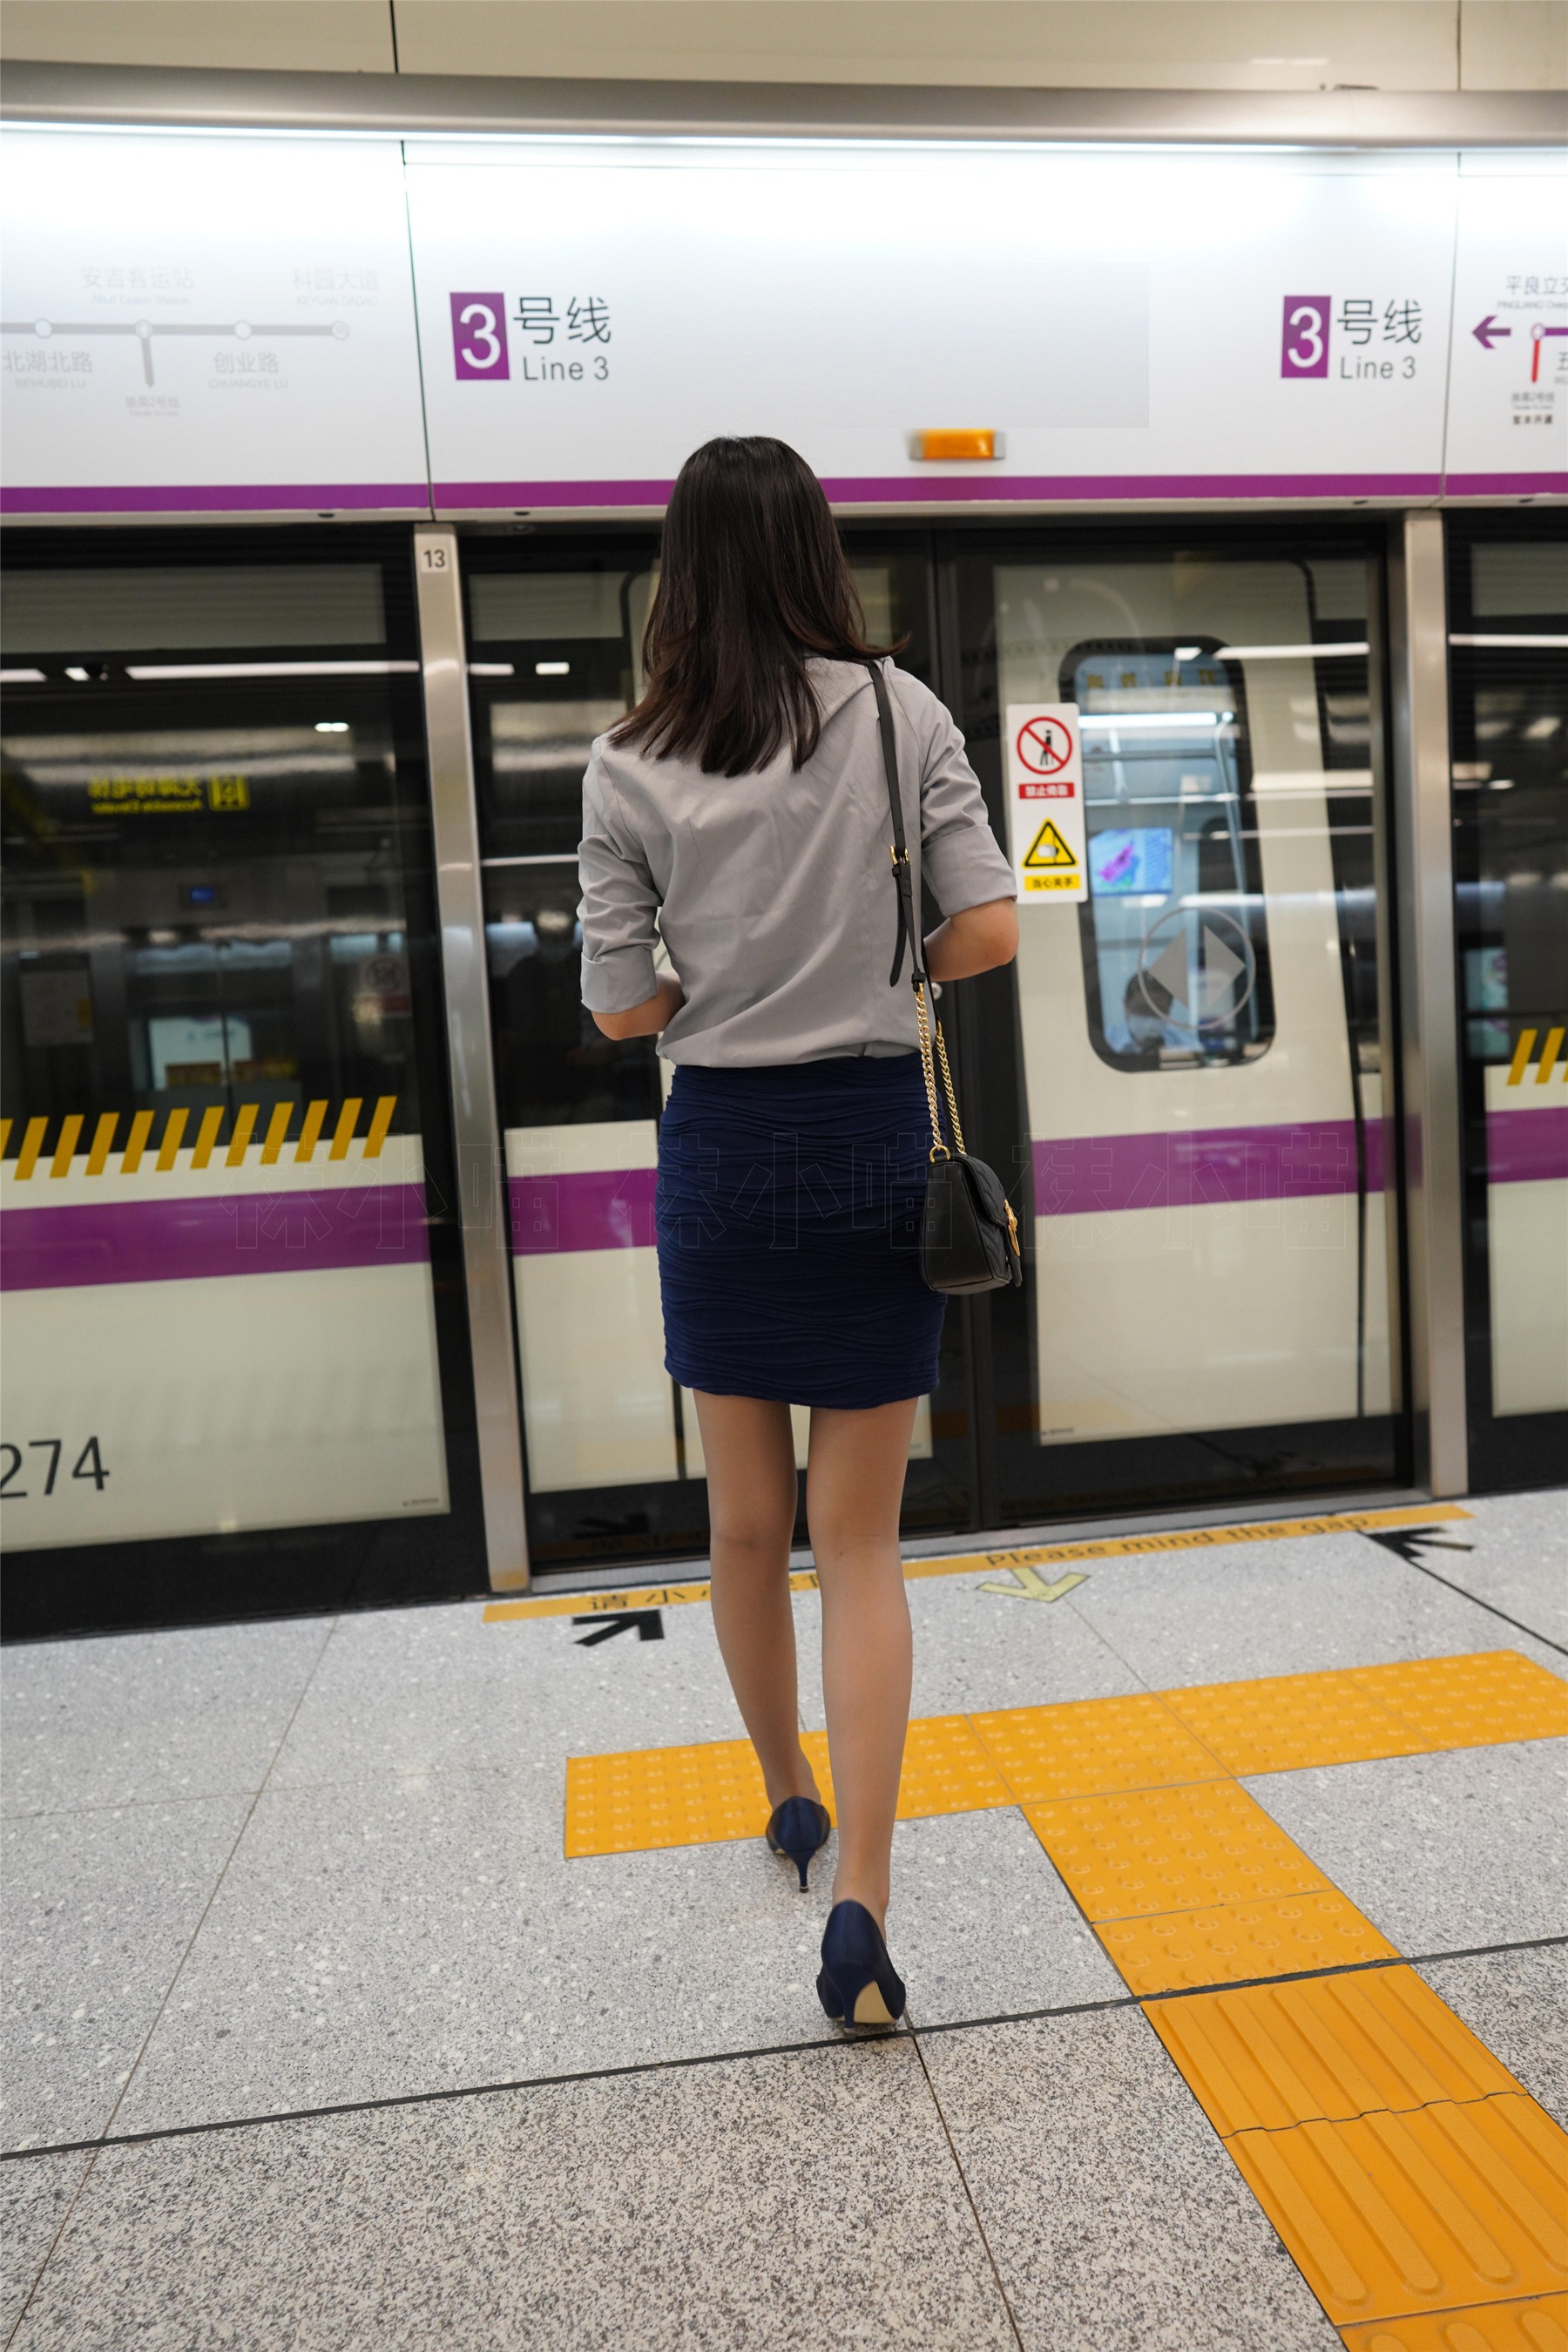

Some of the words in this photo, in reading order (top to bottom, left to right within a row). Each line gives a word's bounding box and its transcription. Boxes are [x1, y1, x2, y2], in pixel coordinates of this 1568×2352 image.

[293, 267, 380, 290] 科园大道
[459, 303, 502, 368] 3
[1287, 306, 1324, 368] 3
[2, 350, 92, 374] 北湖北路
[213, 351, 280, 374] 创业路
[523, 356, 584, 381] Line
[593, 355, 610, 381] 3
[1341, 355, 1394, 380] Line
[1402, 355, 1416, 380] 3
[423, 549, 445, 568] 13
[985, 1545, 1106, 1566] Please
[1121, 1531, 1215, 1552] mind
[1226, 1526, 1288, 1541] the
